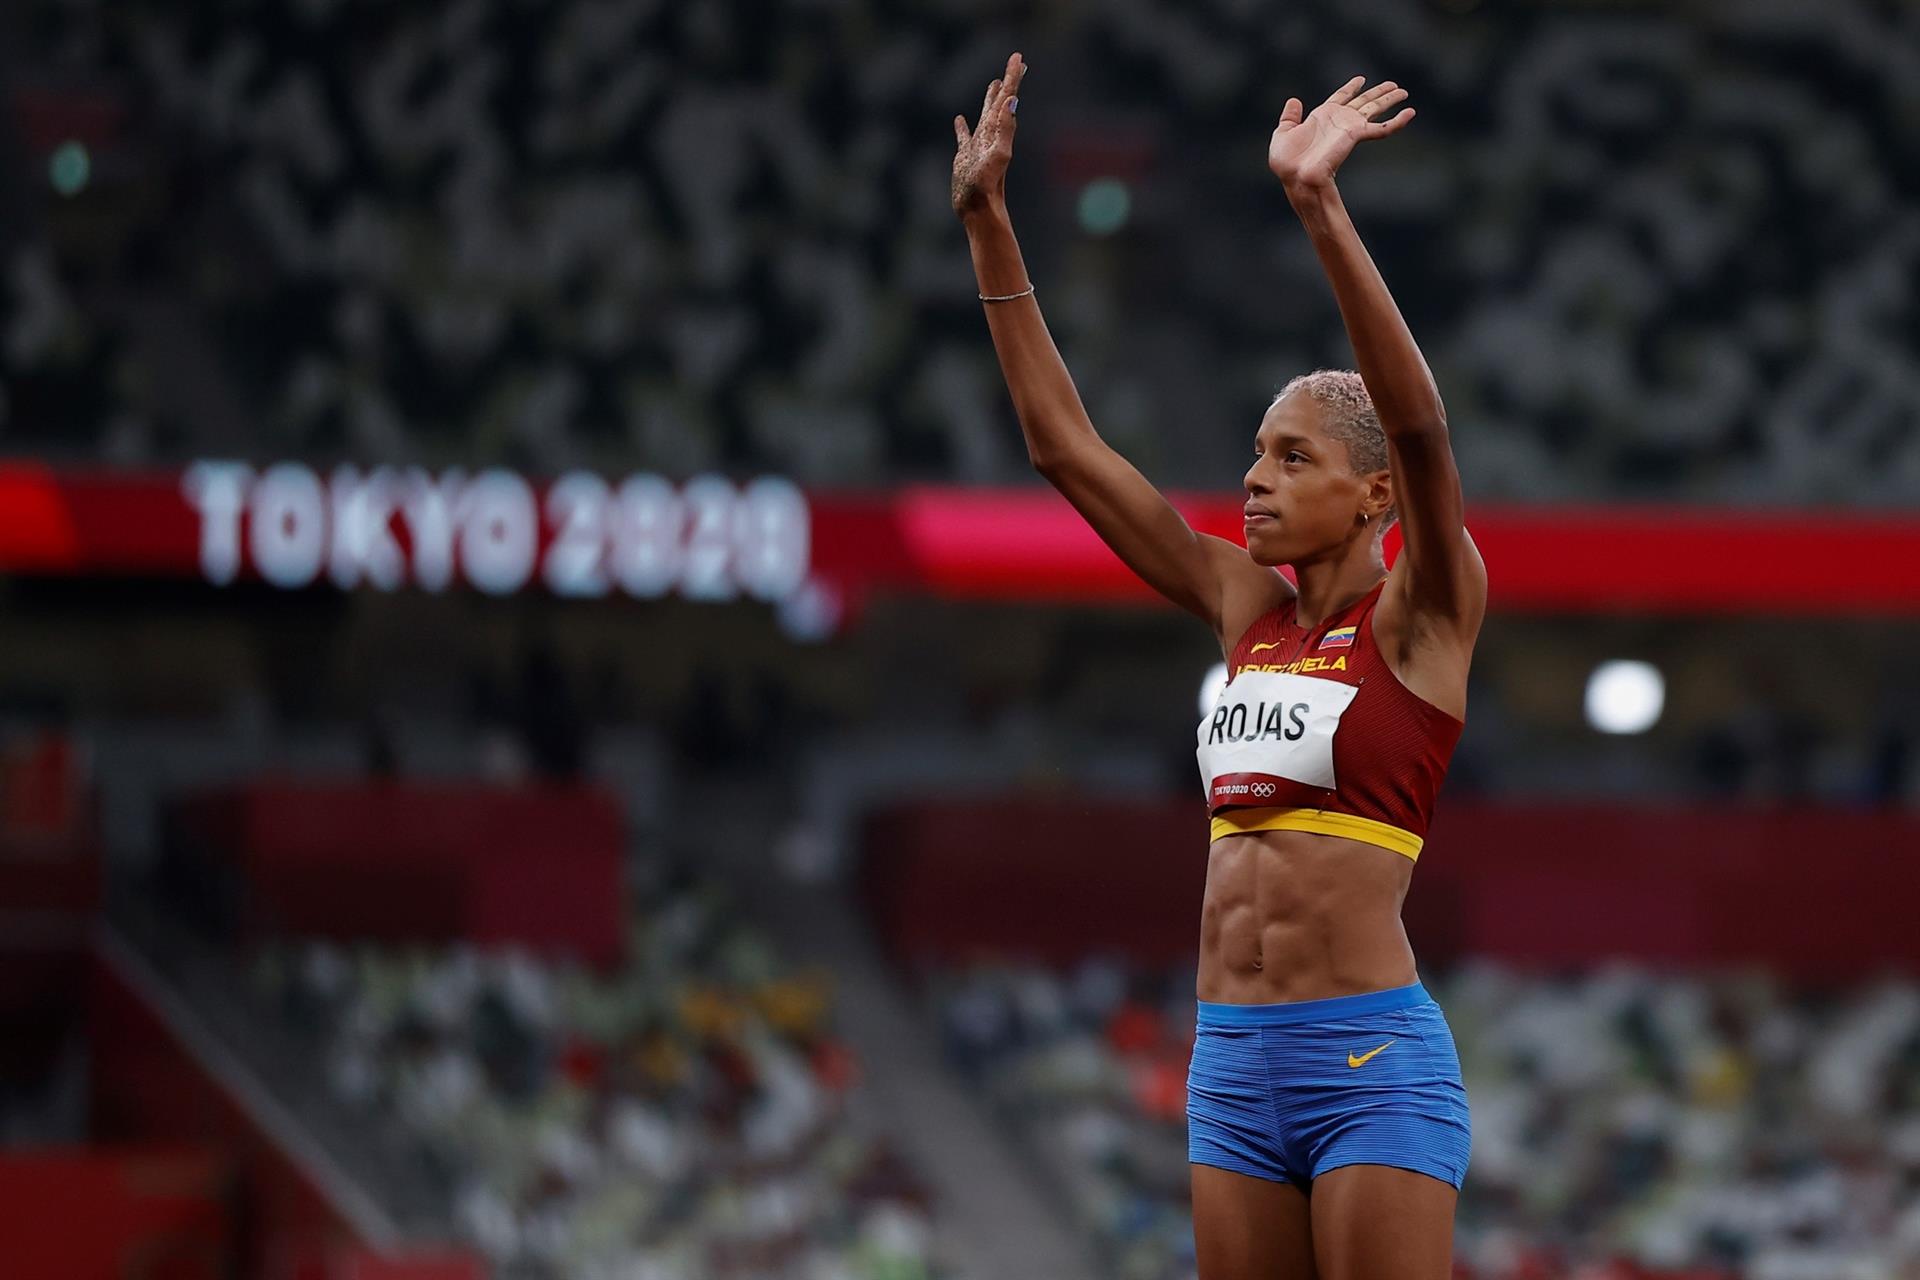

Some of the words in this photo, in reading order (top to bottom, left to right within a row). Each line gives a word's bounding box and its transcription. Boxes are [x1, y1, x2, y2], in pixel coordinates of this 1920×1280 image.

[183, 460, 539, 596] TOKYO
[546, 472, 812, 601] 2020
[1208, 702, 1310, 745] ROJAS
[1230, 784, 1249, 794] 2020
